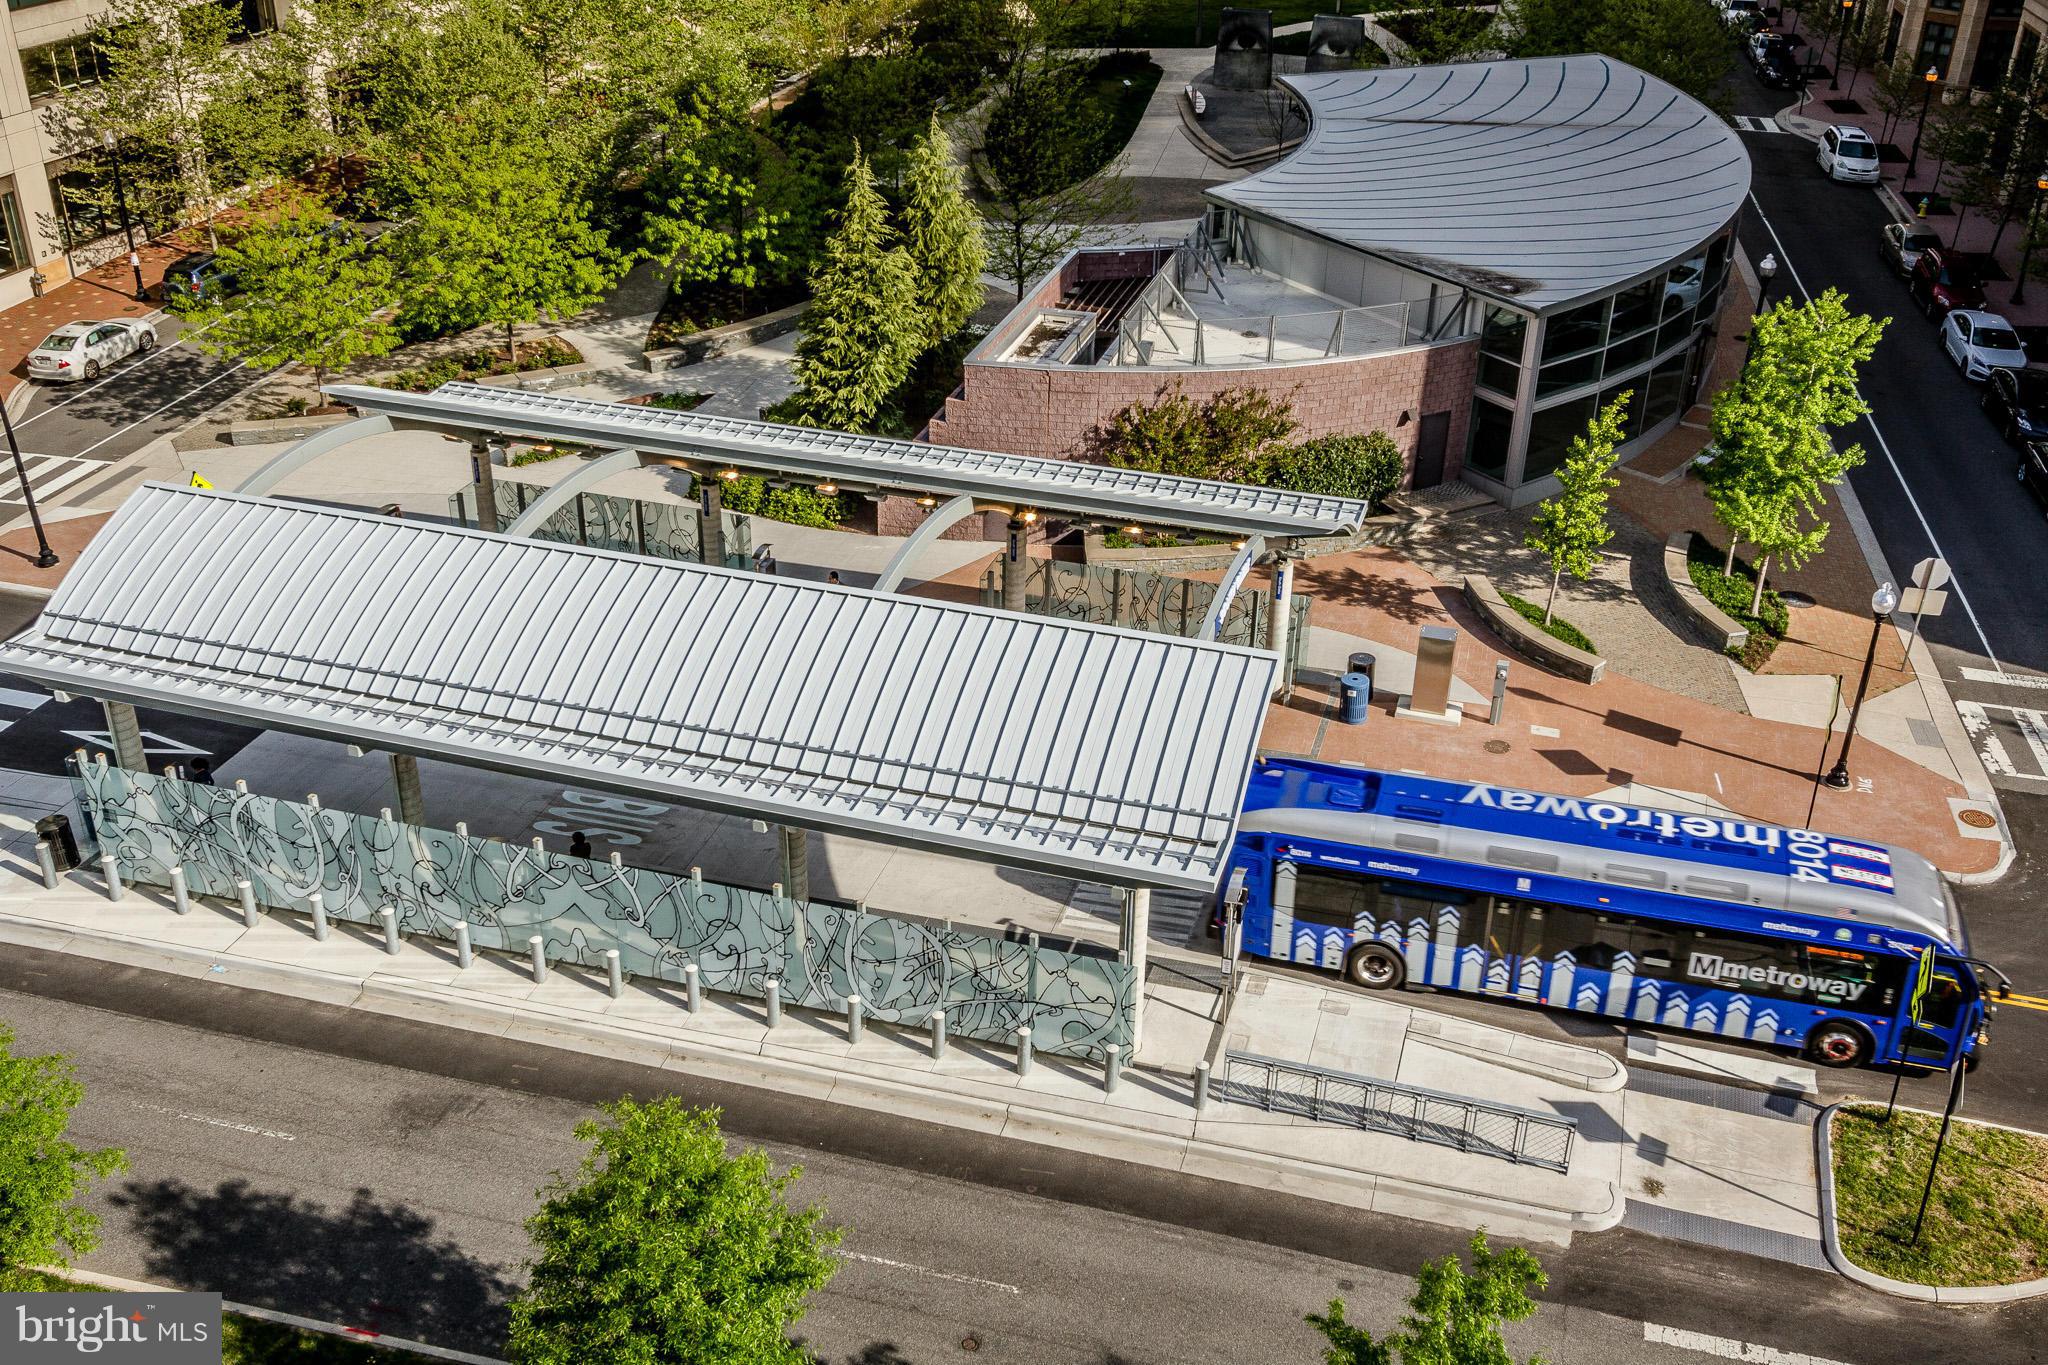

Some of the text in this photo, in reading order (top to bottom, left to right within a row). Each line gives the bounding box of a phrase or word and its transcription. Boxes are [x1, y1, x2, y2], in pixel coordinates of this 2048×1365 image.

[533, 790, 670, 845] BUS
[1458, 784, 1780, 849] metroway
[1786, 829, 1830, 883] 8014
[1721, 961, 1867, 1001] metroway
